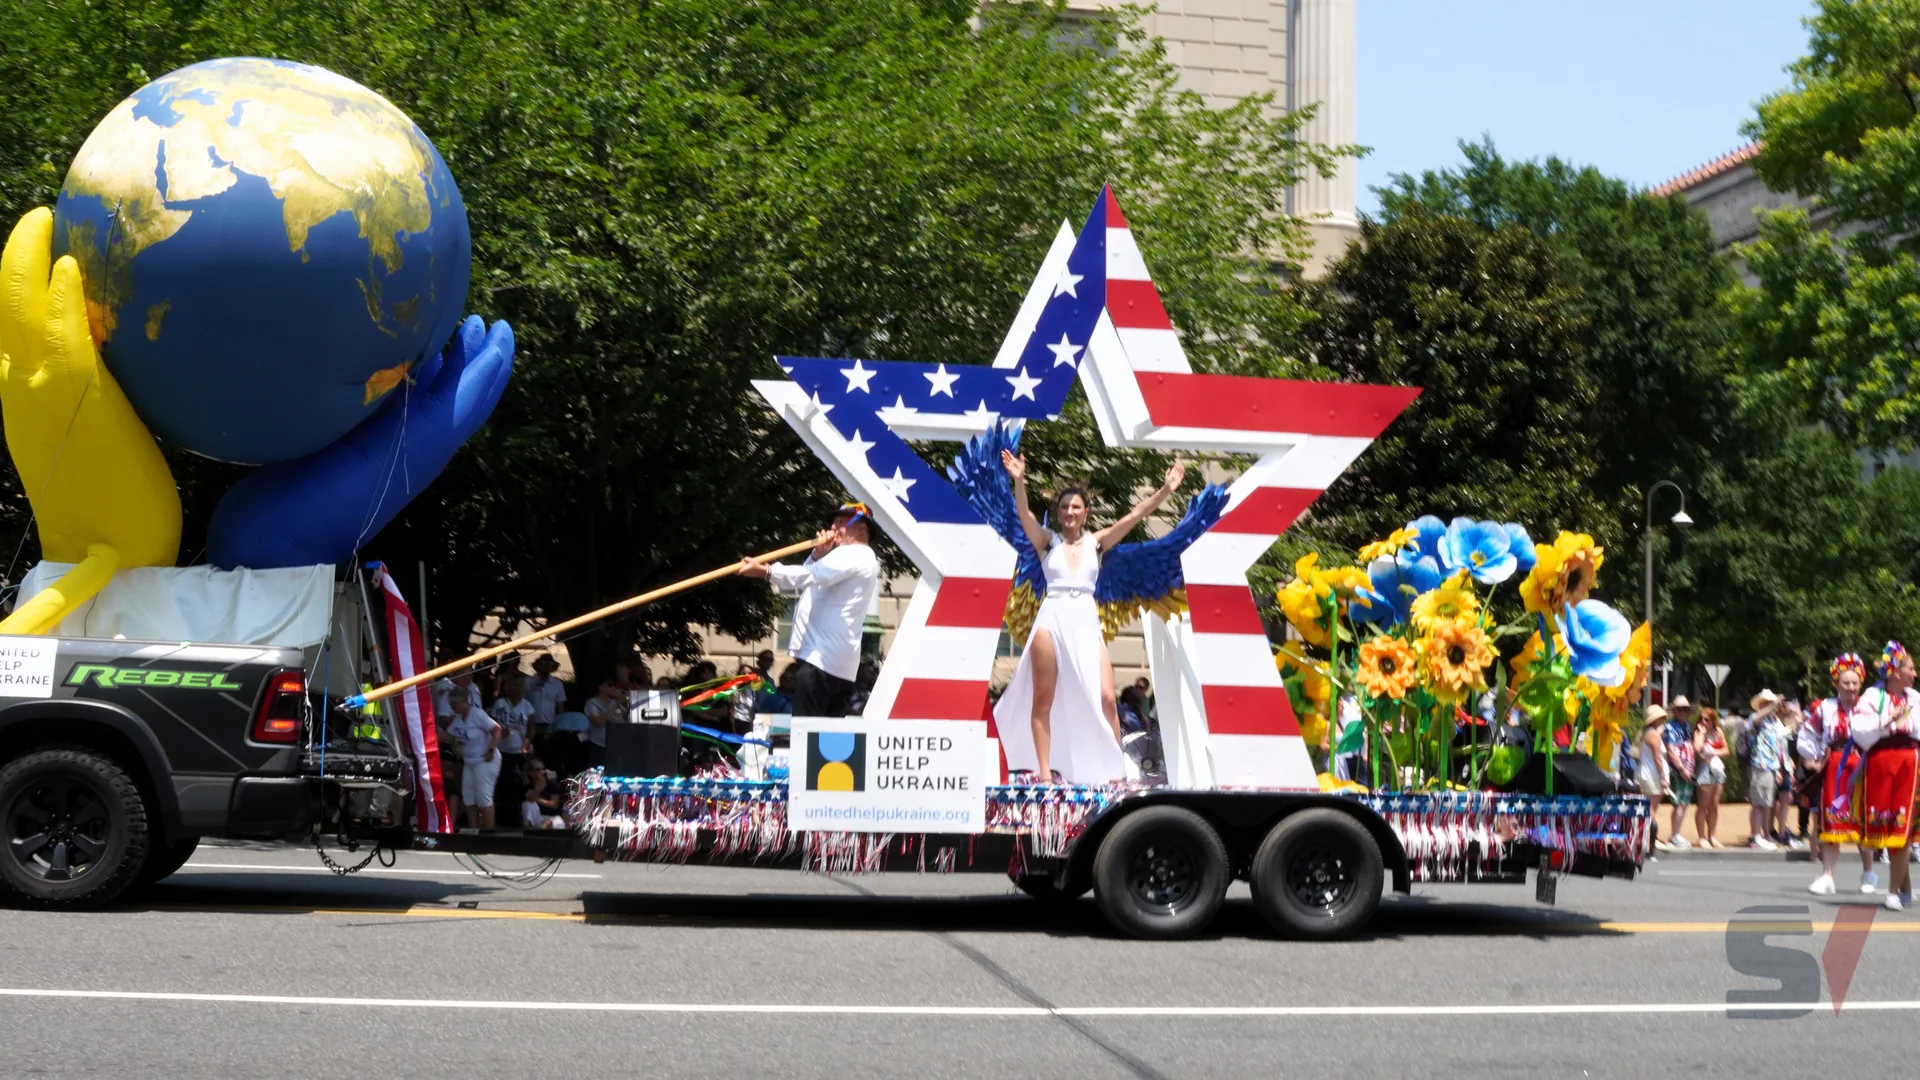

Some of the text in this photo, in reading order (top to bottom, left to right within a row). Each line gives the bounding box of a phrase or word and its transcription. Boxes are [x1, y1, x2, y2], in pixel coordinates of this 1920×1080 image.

[66, 664, 241, 690] REBEL
[877, 735, 953, 752] UNITED
[876, 755, 930, 771] HELP
[876, 775, 970, 791] UKRAINE
[804, 805, 971, 824] unitedhelpukraine.org
